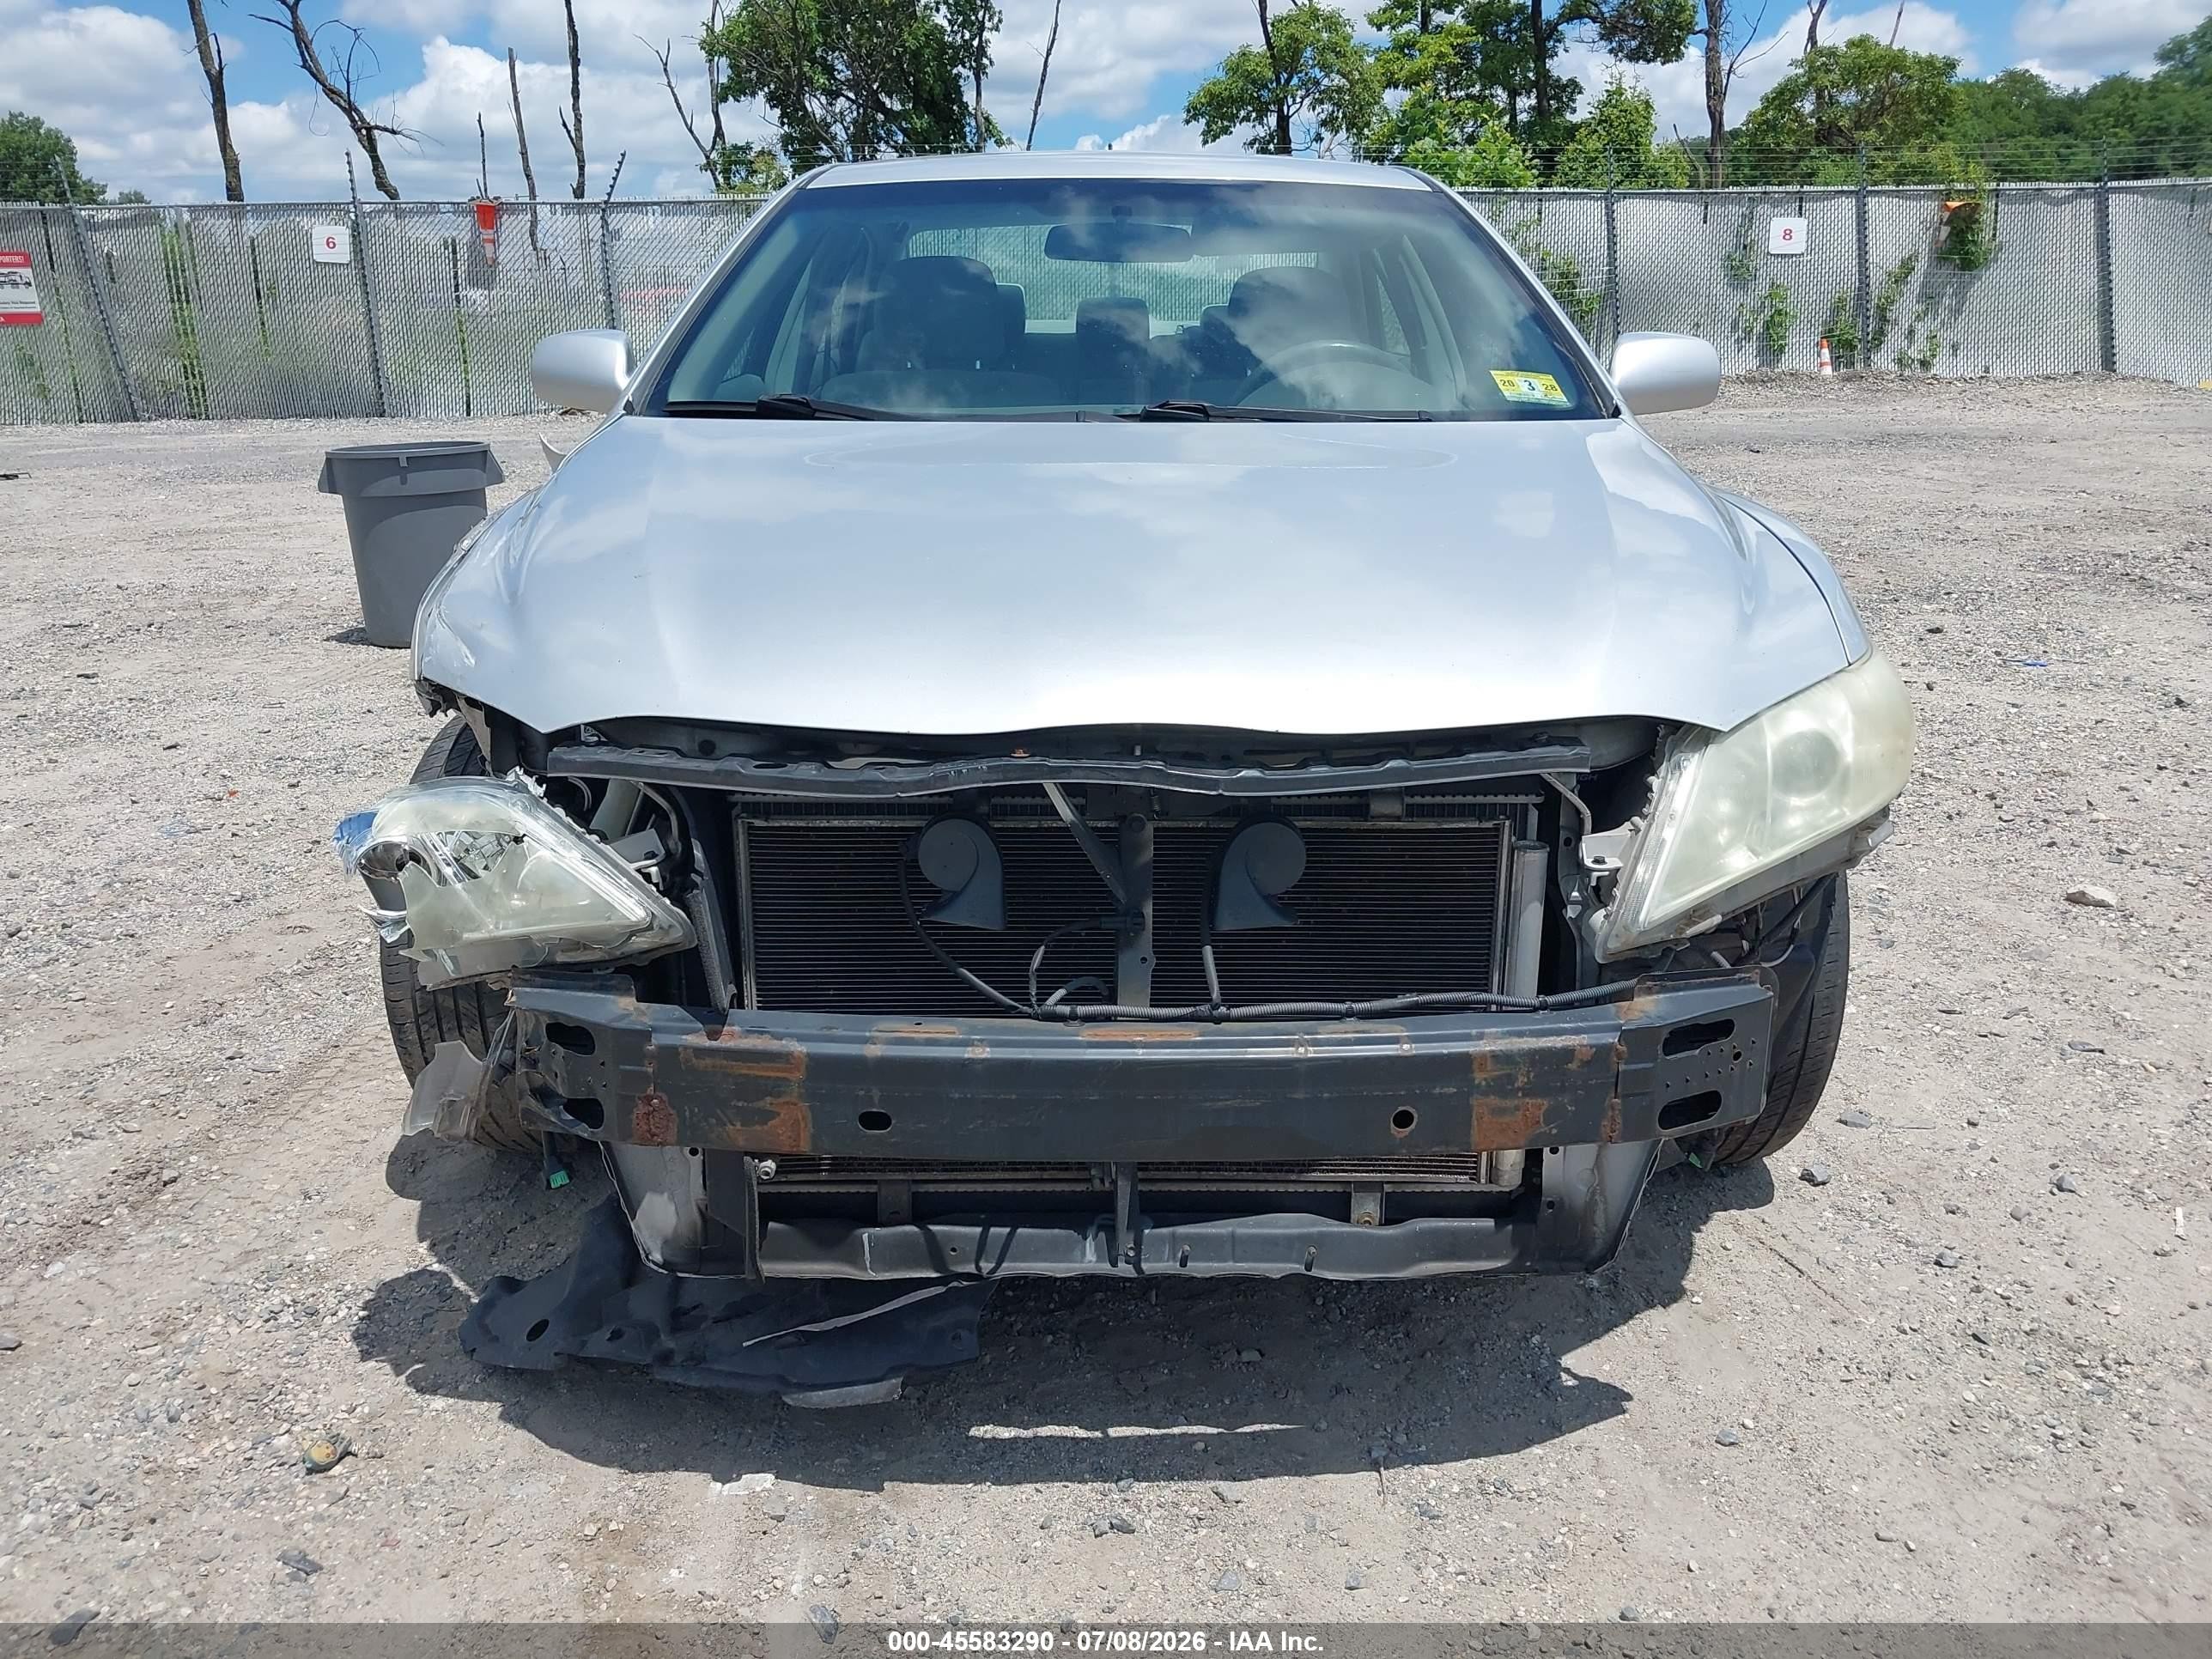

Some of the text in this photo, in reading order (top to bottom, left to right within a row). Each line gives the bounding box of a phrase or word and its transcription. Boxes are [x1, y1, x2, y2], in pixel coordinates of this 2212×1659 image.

[1782, 228, 1793, 241] 8
[325, 236, 337, 249] 6
[1499, 379, 1559, 392] 20 3 28
